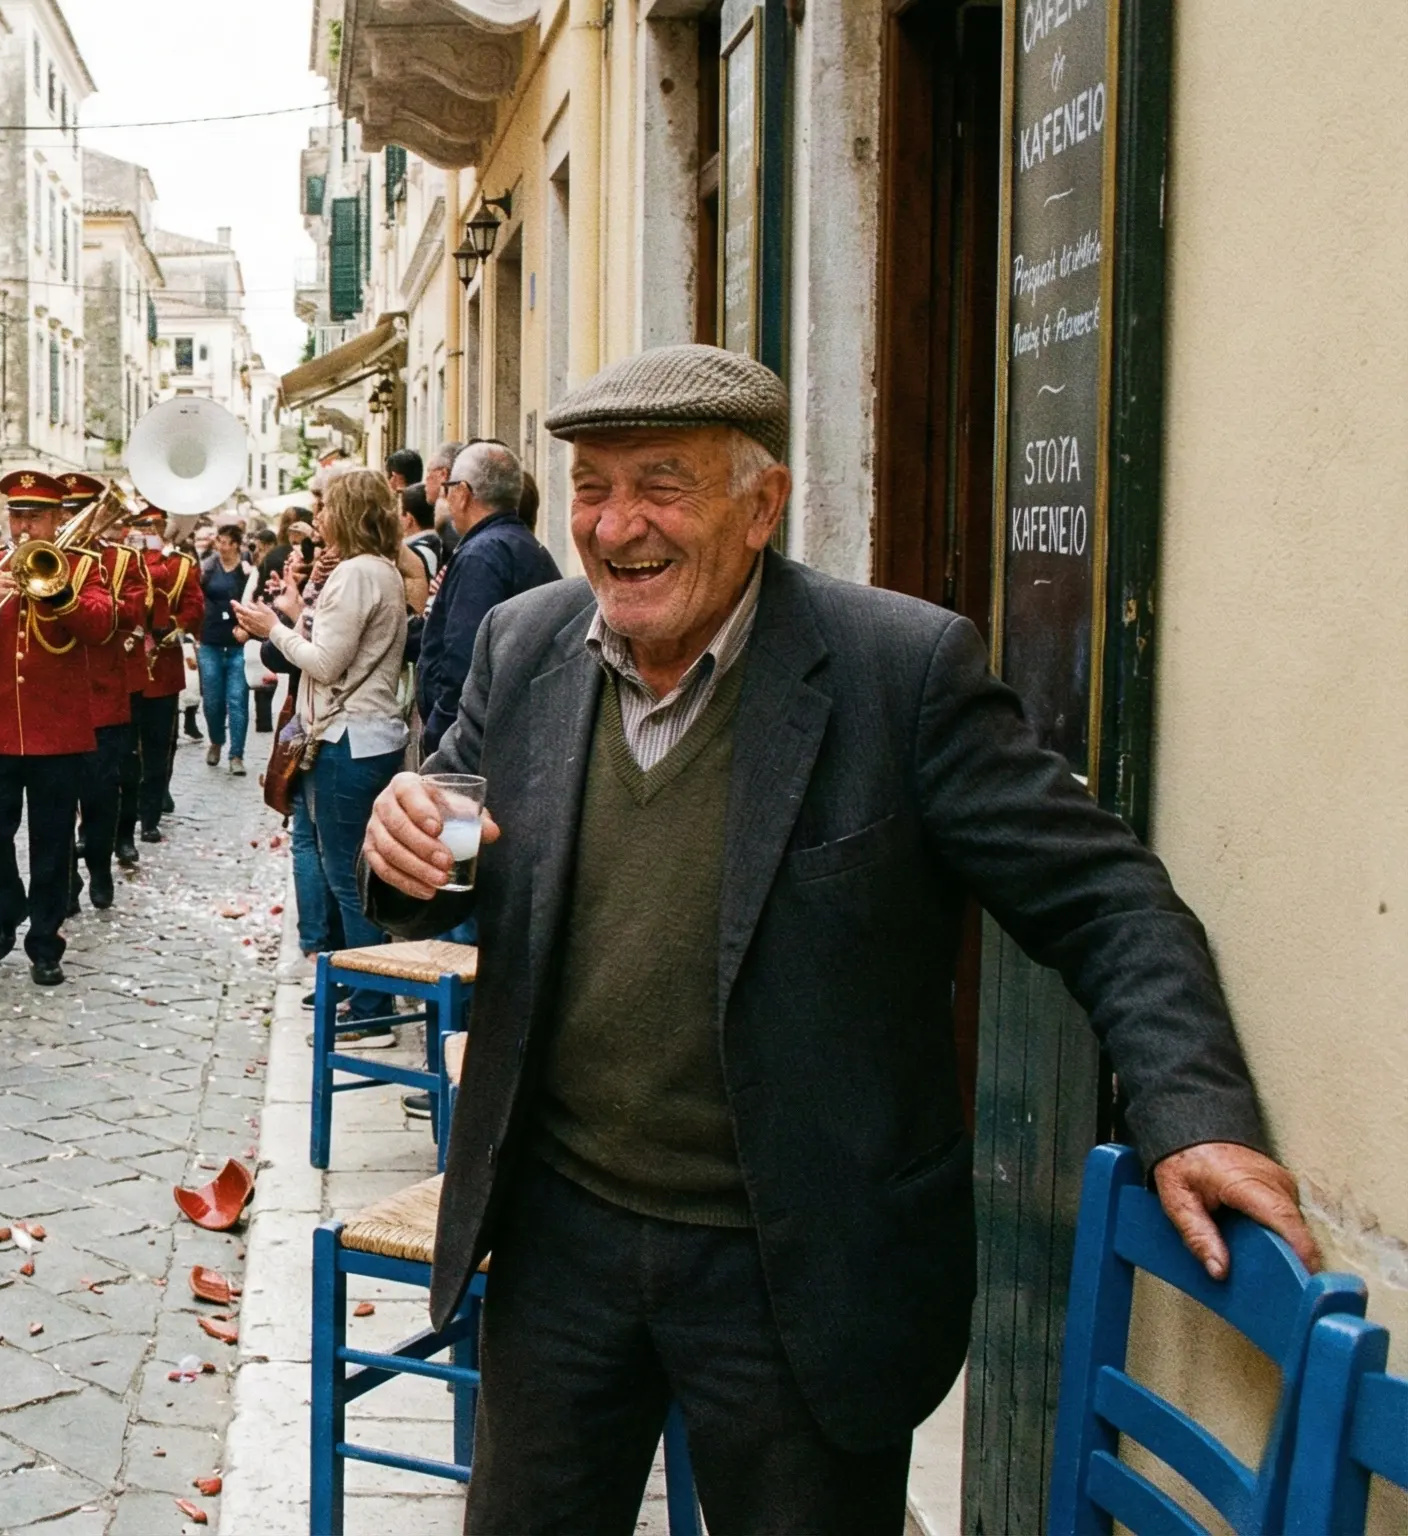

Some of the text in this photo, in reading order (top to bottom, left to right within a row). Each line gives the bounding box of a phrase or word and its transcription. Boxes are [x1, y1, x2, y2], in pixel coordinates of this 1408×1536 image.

[1023, 0, 1088, 53] CAFE
[1020, 82, 1105, 173] KAFENEIO
[1024, 435, 1081, 485] STOYA
[1012, 505, 1087, 556] KAFENEIO
